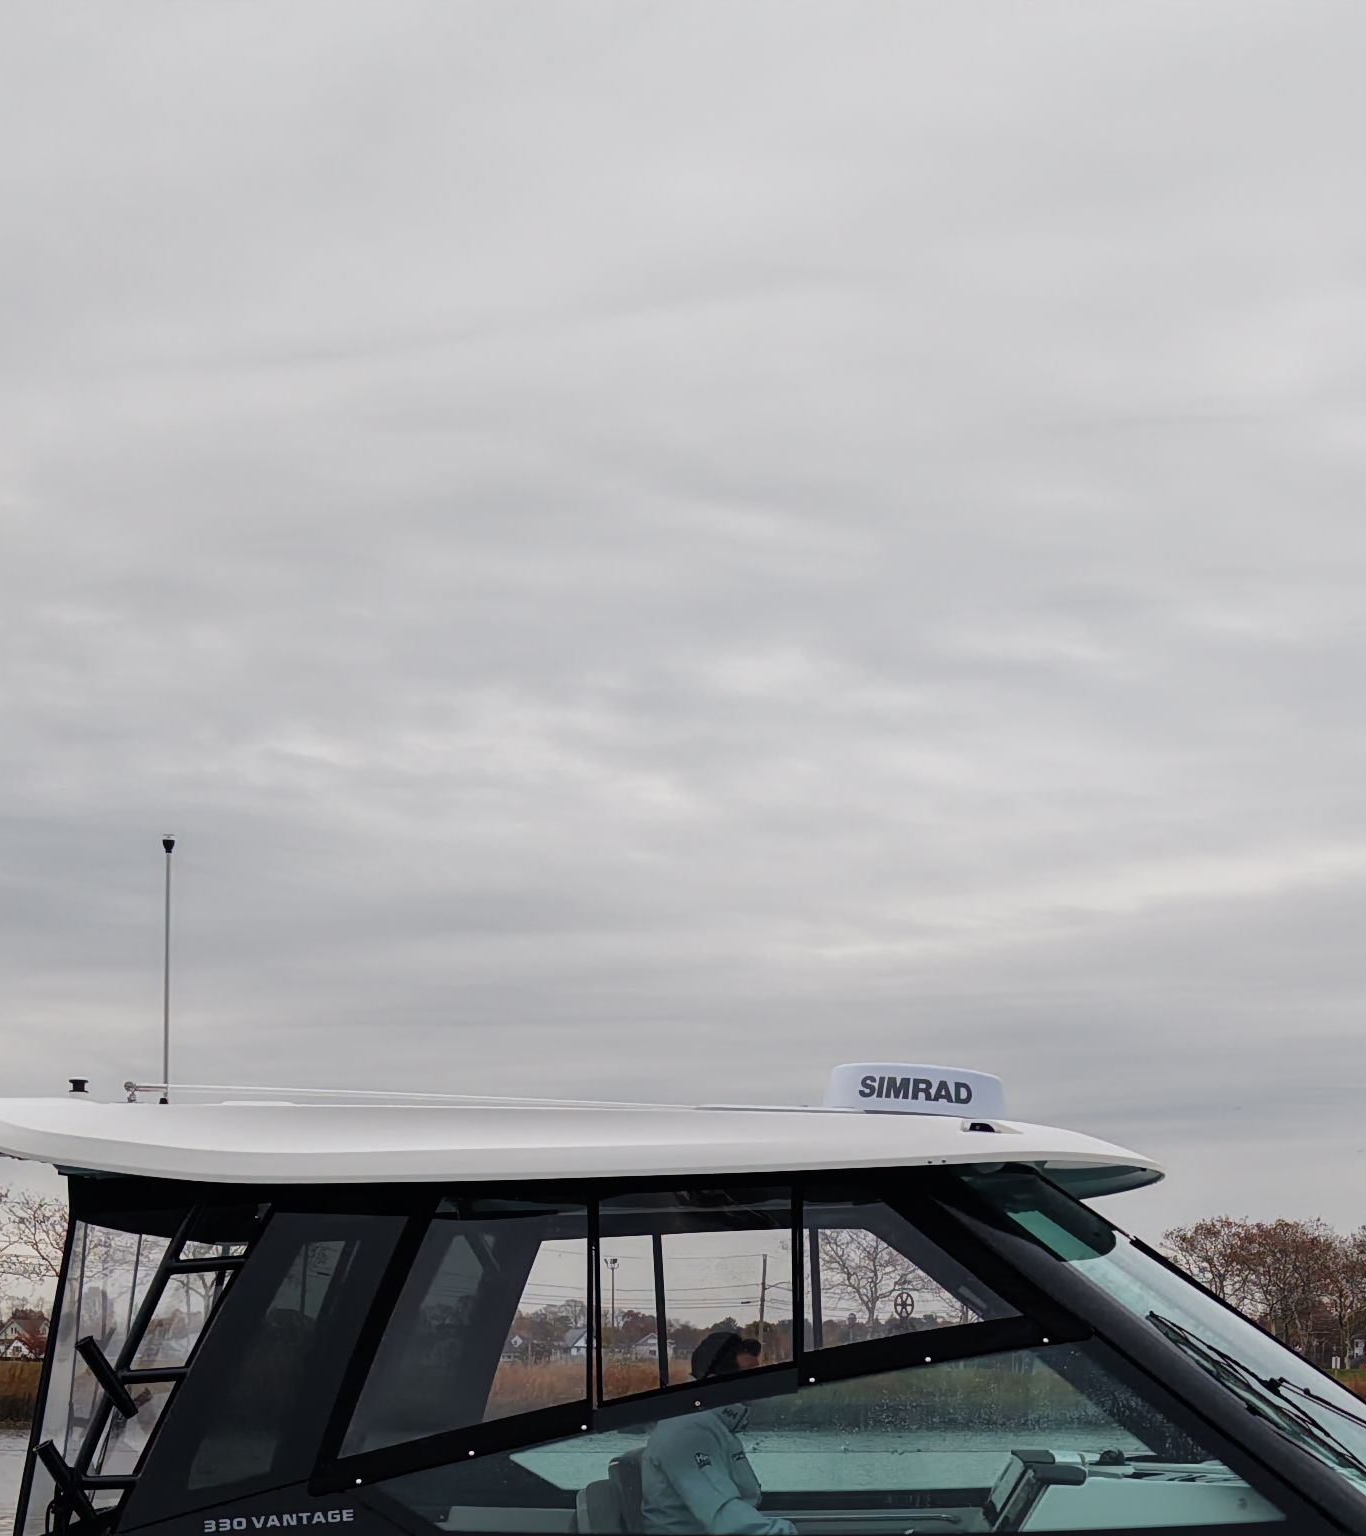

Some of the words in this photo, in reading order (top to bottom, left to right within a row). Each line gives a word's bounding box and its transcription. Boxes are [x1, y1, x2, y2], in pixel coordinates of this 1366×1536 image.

[858, 1075, 973, 1105] SIMRAD
[204, 1517, 247, 1533] 330
[251, 1508, 355, 1529] VANTAGE
